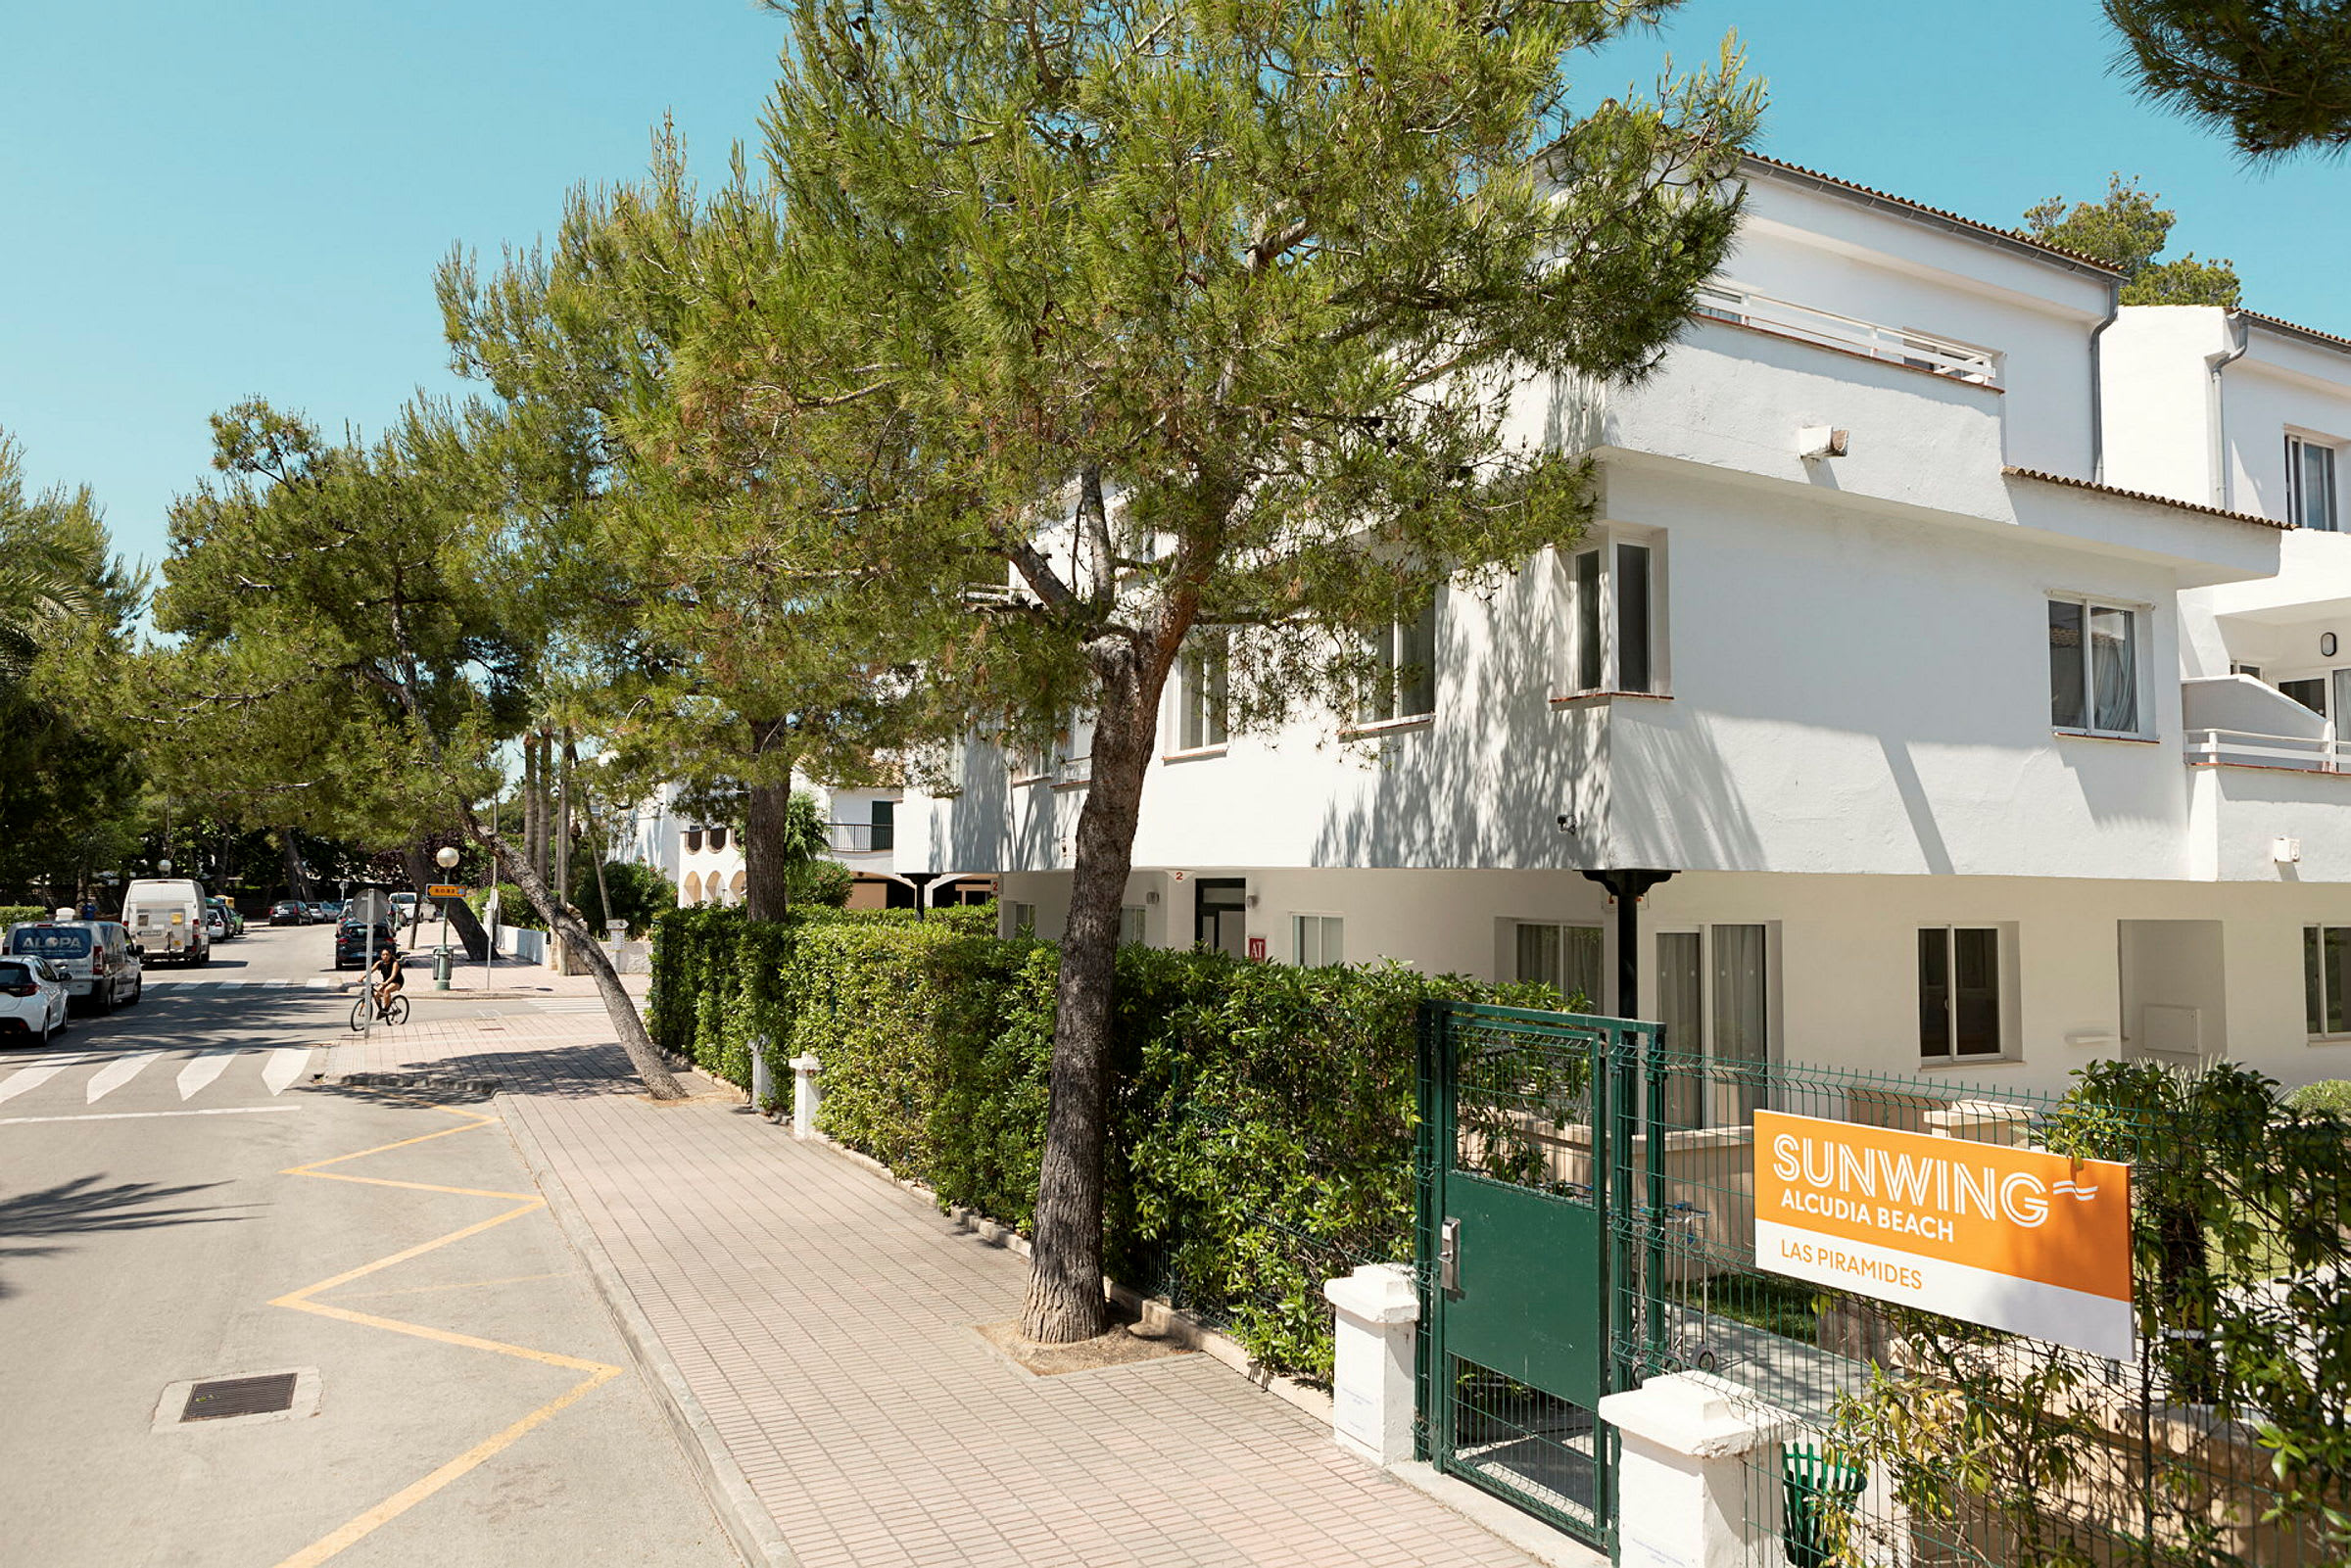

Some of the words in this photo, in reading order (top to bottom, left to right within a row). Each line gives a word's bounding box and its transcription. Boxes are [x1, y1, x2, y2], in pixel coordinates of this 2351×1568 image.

[1176, 872, 1183, 880] 2
[22, 936, 82, 949] ALOPA
[1250, 941, 1264, 959] AT
[1774, 1134, 2049, 1228] SUNWING
[1781, 1188, 1871, 1225] ALCUDIA
[1877, 1207, 1954, 1243] BEACH
[1781, 1239, 1812, 1263] LAS
[1818, 1248, 1923, 1290] PIRAMIDES
